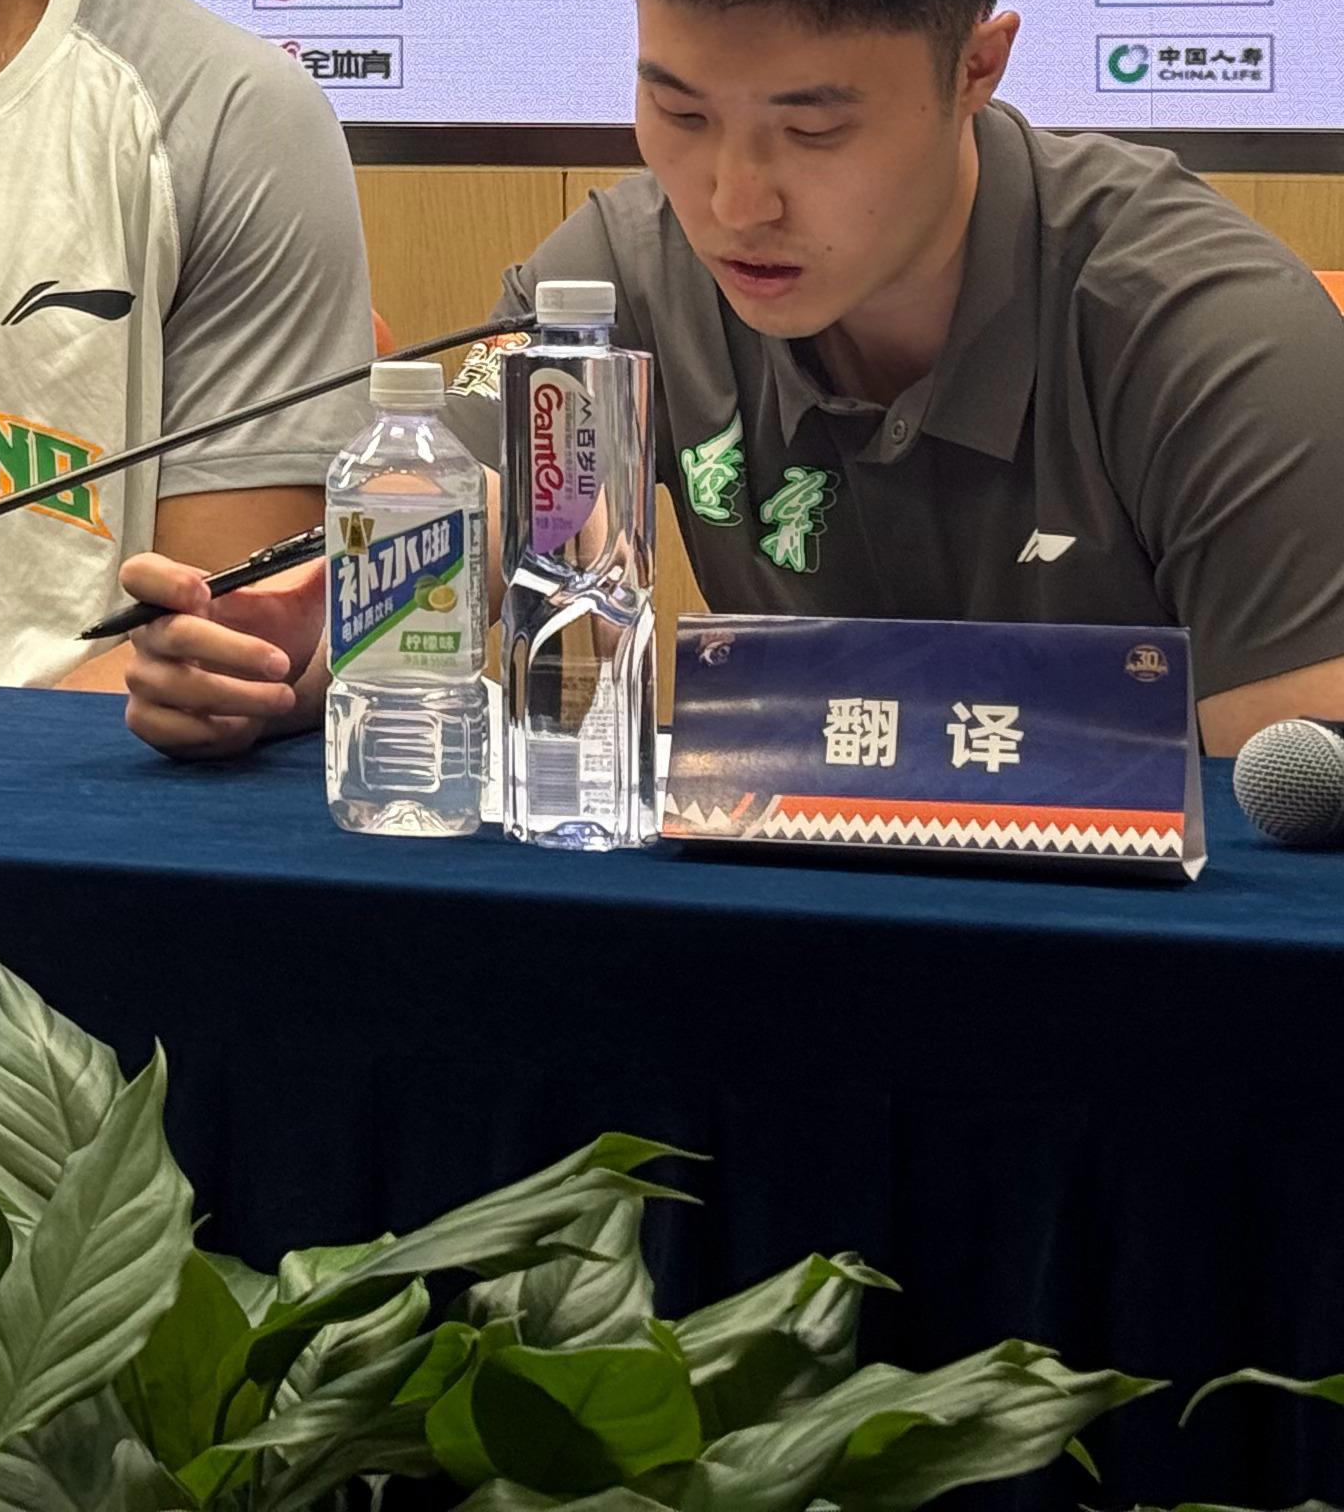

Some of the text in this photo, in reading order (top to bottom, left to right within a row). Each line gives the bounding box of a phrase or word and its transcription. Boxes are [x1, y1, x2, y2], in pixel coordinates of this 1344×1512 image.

[1158, 47, 1262, 66] 中国人寿
[1158, 69, 1262, 80] CHINA LIFE
[577, 428, 597, 499] 百岁山
[338, 519, 451, 620] 补水啦
[406, 635, 456, 651] 柠檬味
[1136, 651, 1159, 666] 30
[822, 696, 1025, 774] 翻译
